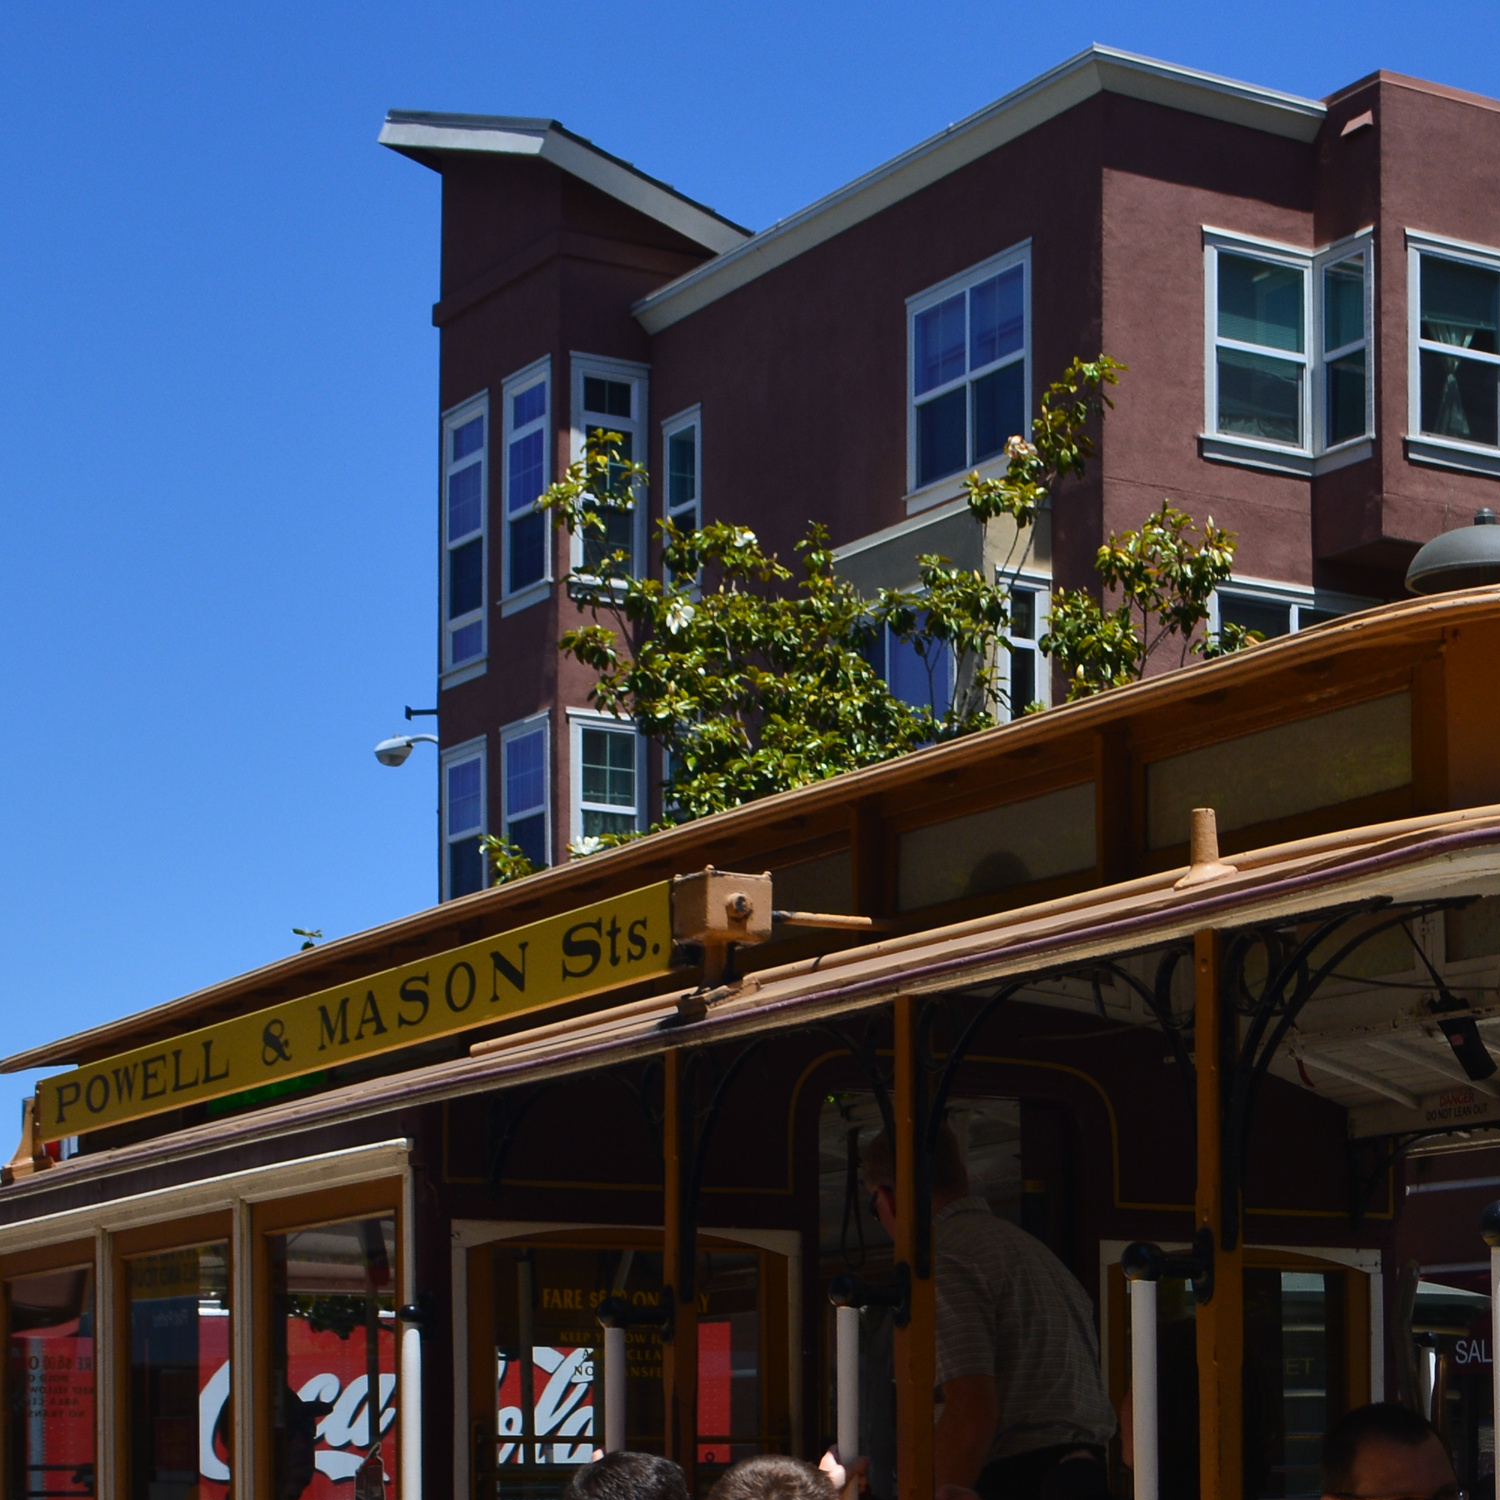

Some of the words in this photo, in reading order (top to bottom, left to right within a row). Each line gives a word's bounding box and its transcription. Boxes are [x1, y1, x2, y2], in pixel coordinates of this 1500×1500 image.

[55, 1037, 230, 1124] POWELL
[261, 1018, 293, 1067] &
[318, 940, 530, 1052] MASON
[560, 915, 661, 981] Sts.
[1439, 1091, 1475, 1107] DANGER
[1426, 1110, 1437, 1121] DO
[1437, 1107, 1453, 1120] NOT
[1454, 1105, 1472, 1118] LEAN
[1472, 1103, 1487, 1115] OUT
[541, 1288, 584, 1309] FARE
[560, 1330, 591, 1342] KEEP
[627, 1352, 664, 1362] CLEA
